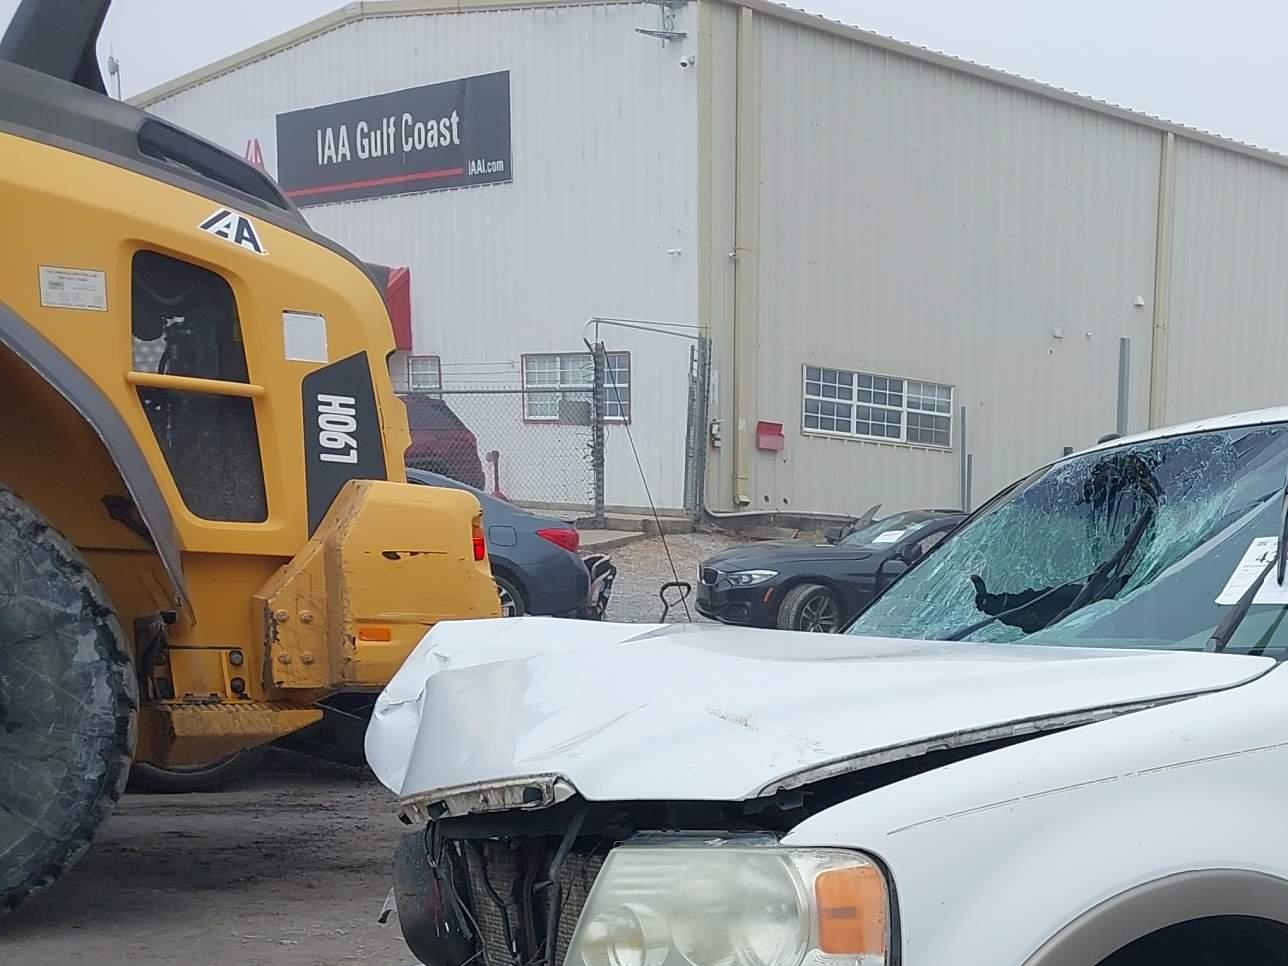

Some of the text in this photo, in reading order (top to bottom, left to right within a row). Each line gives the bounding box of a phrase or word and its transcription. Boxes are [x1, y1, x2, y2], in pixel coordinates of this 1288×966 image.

[317, 109, 461, 166] IAA Gulf Coast
[317, 393, 358, 465] L90H
